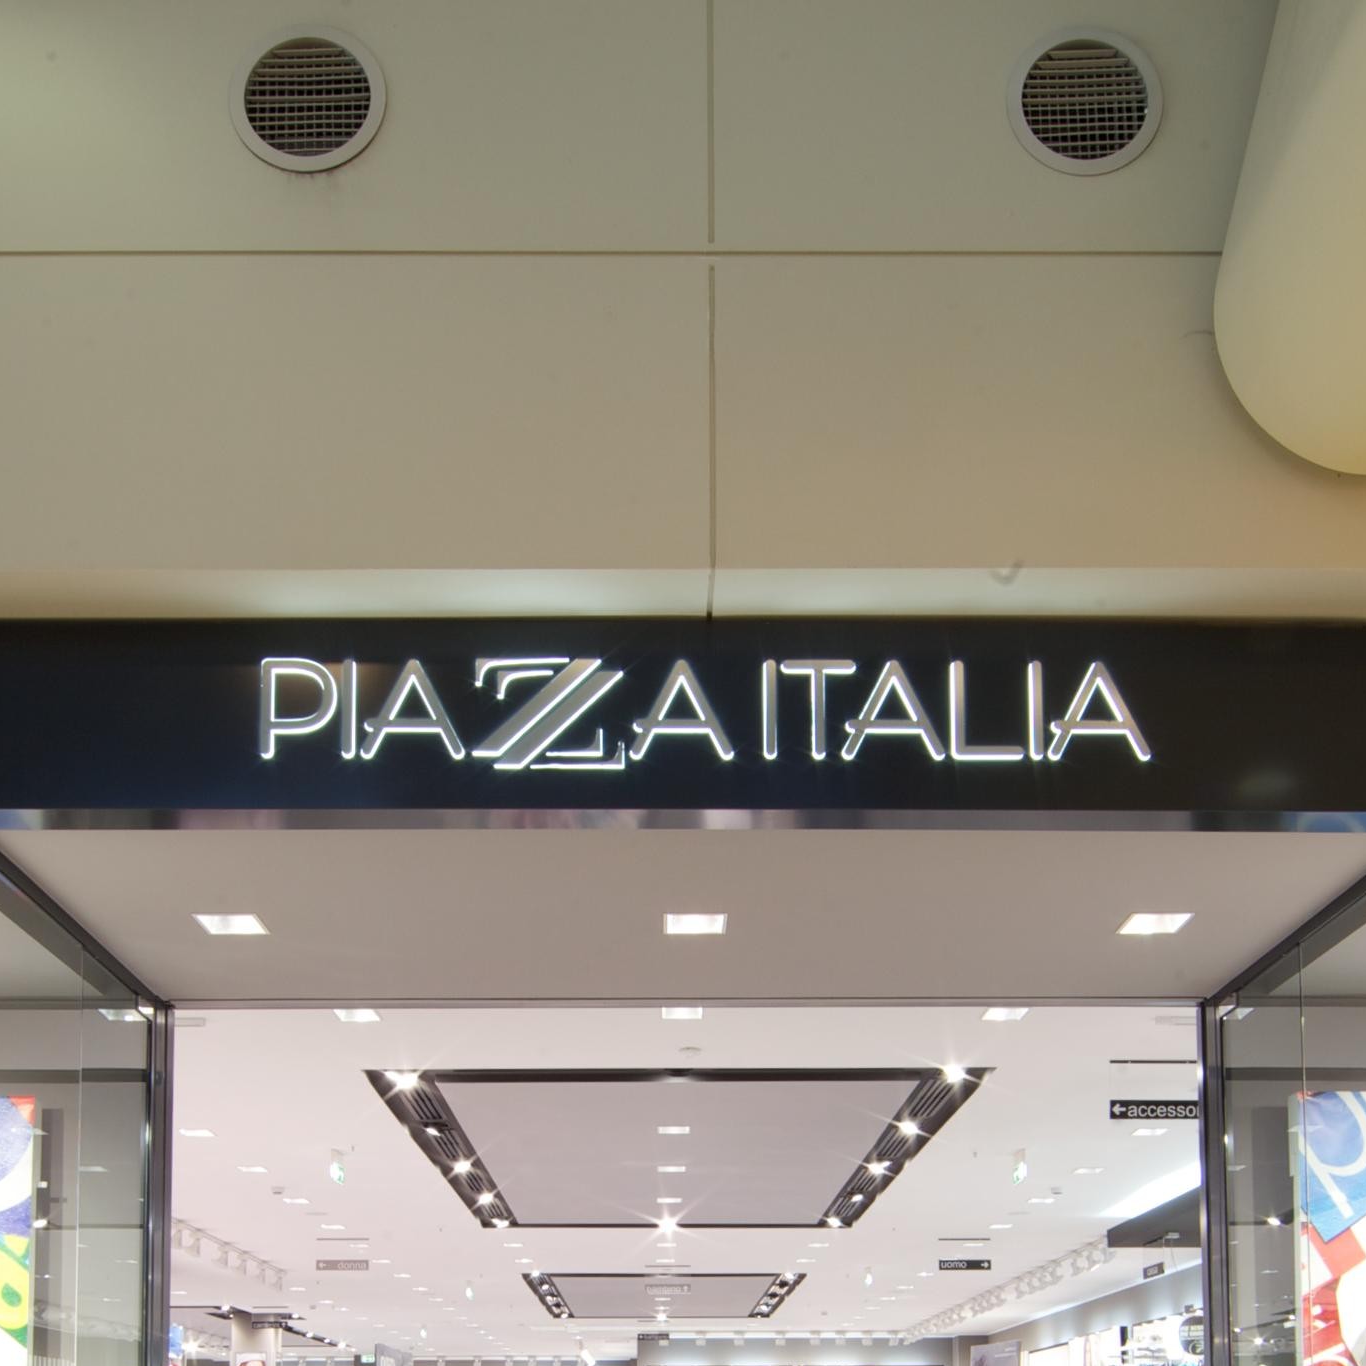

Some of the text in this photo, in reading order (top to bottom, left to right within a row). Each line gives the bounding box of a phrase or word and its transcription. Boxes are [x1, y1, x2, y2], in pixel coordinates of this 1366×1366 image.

[260, 656, 1153, 770] PIAZZA ITALIA
[337, 1261, 367, 1270] donna
[940, 1261, 967, 1269] uomo
